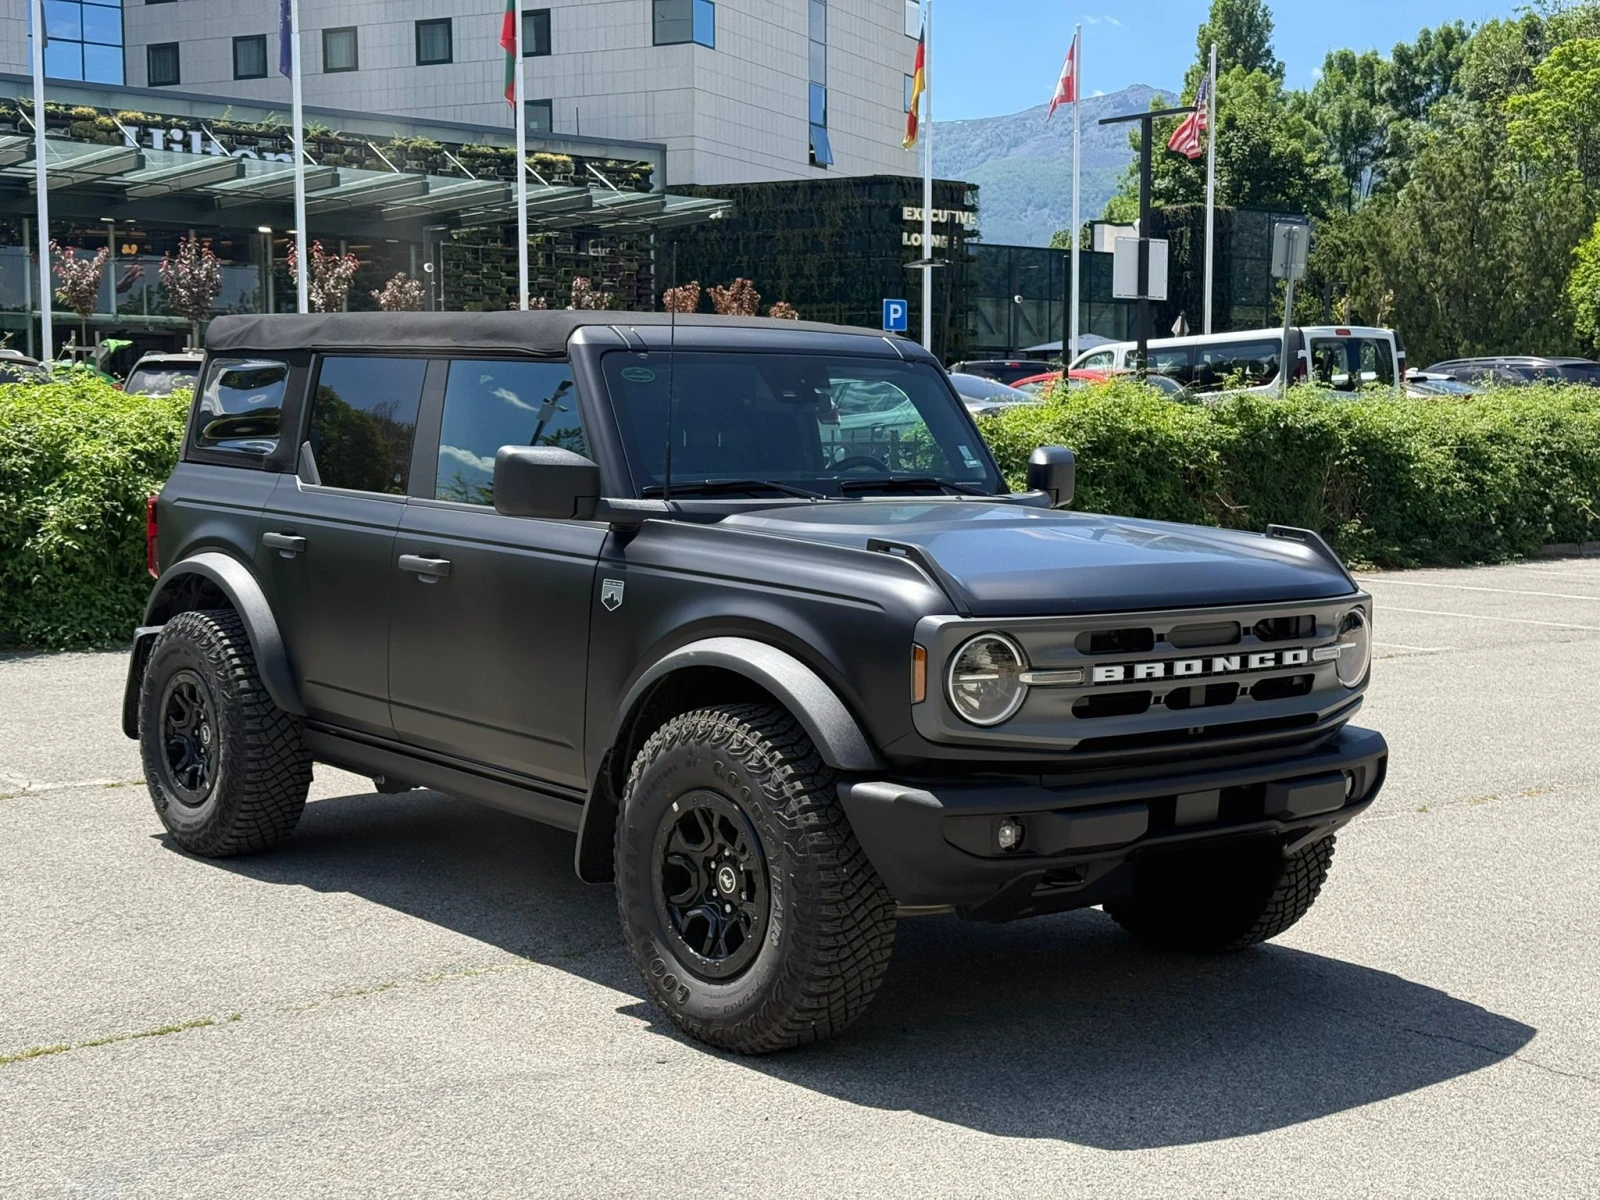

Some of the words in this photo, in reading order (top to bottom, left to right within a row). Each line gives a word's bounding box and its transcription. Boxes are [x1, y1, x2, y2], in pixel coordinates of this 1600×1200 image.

[123, 125, 293, 163] Hilt
[902, 231, 958, 249] LONG
[890, 304, 903, 327] P
[1092, 649, 1308, 683] BRONCO
